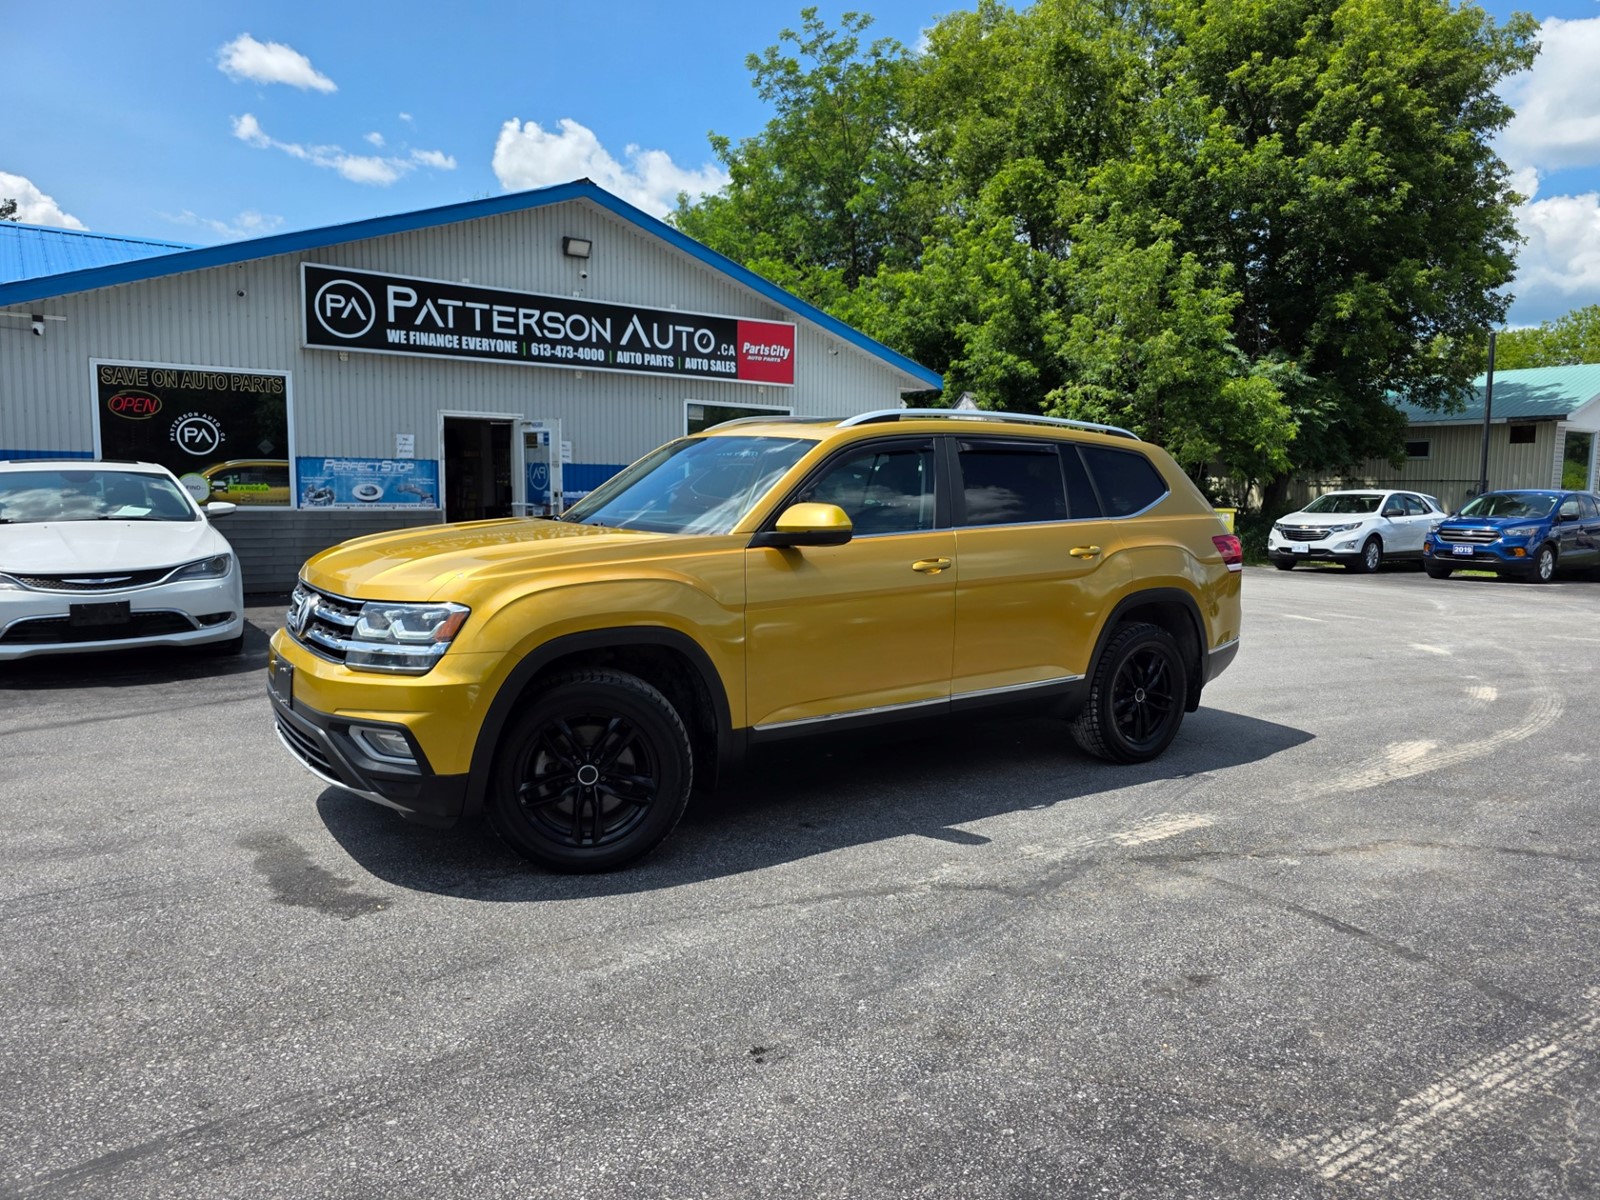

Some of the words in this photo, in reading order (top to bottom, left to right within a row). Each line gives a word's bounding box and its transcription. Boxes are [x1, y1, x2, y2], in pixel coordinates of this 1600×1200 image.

[386, 284, 611, 344] PATTERSON
[619, 313, 716, 354] AUTO
[386, 328, 407, 344] WE
[409, 331, 460, 349] FINANCE
[461, 336, 518, 354] EVERYONE
[530, 342, 605, 362] 613-473-4000
[616, 351, 643, 365] AUTO
[644, 354, 674, 368] PARTS
[685, 357, 709, 371] AUTO
[710, 359, 736, 373] SALES
[101, 366, 148, 386] SAVE
[151, 369, 178, 388] ON
[181, 370, 228, 390] AUTO
[230, 375, 283, 393] PARTS
[110, 397, 158, 413] OPEN
[170, 411, 199, 441] PATTERSON
[184, 427, 213, 443] PA
